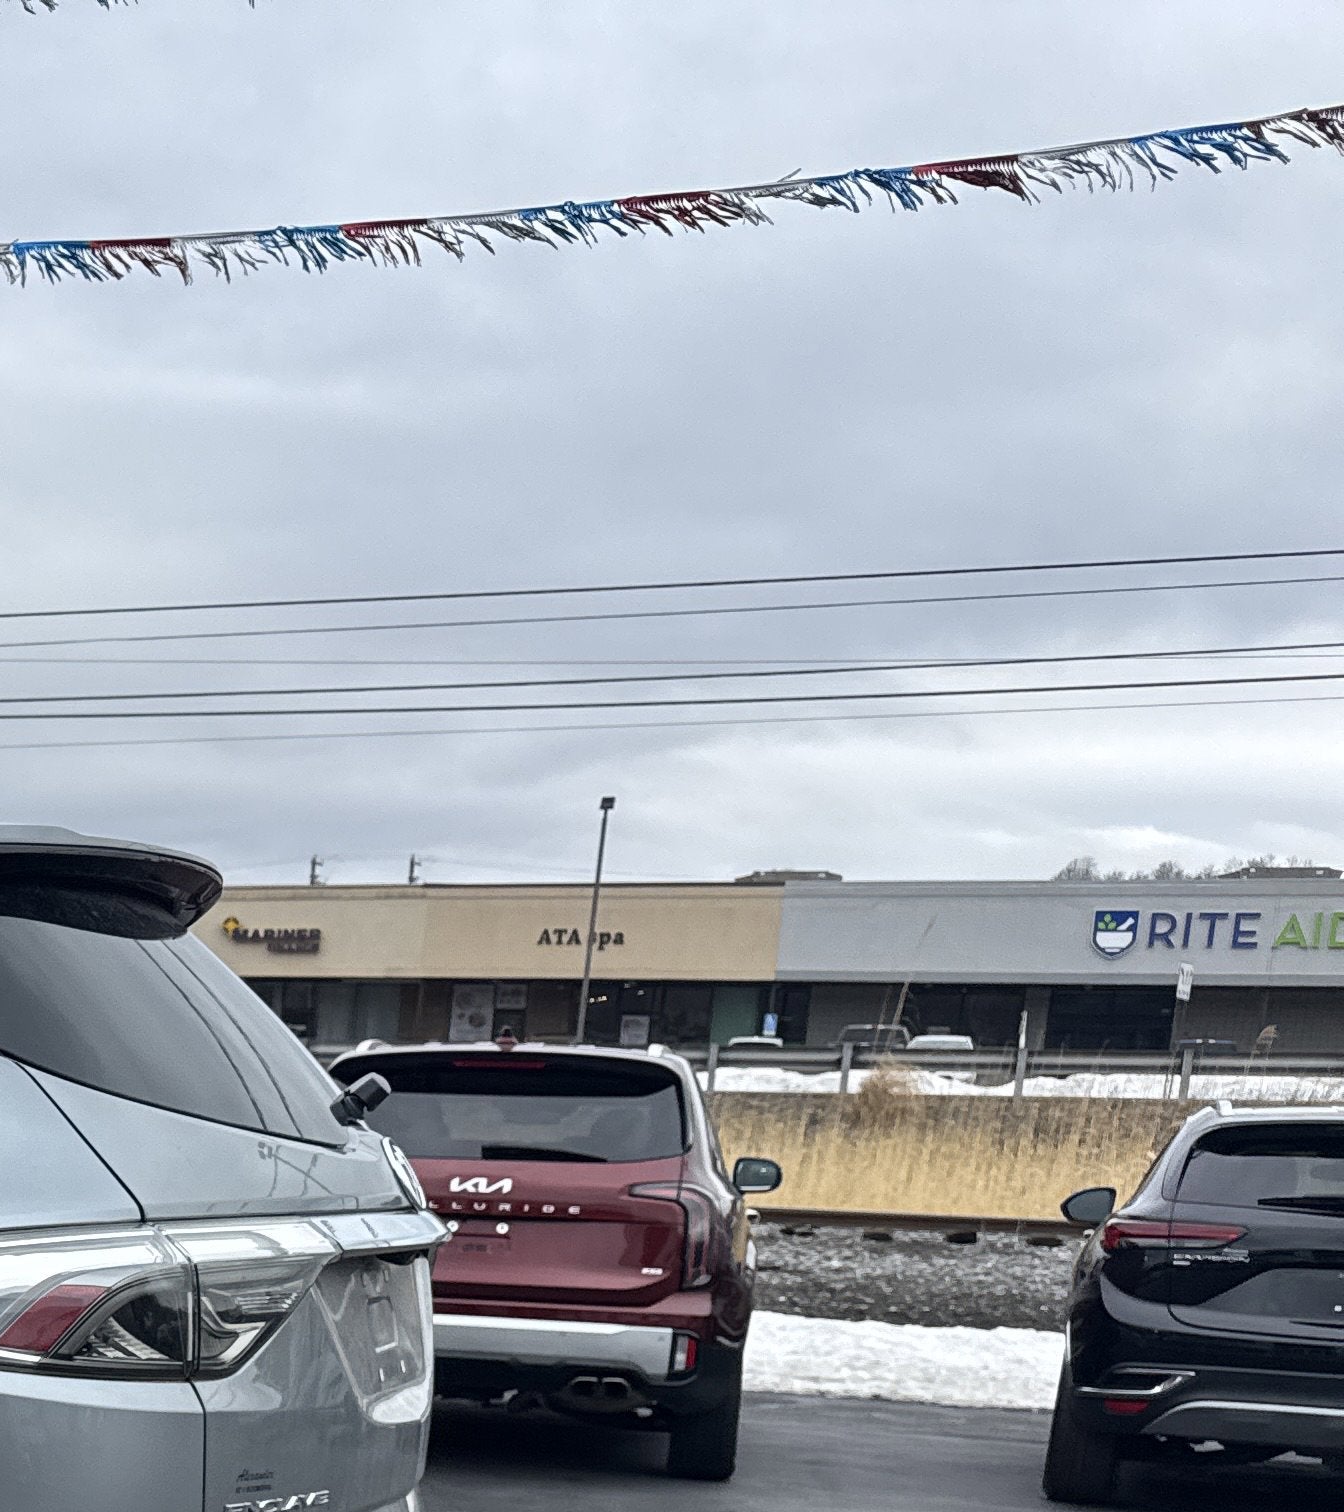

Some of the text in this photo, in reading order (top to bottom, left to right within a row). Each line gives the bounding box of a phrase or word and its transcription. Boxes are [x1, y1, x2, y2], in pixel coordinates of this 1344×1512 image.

[537, 928, 582, 945] ATA
[1148, 911, 1262, 950] RITE
[450, 1176, 513, 1194] KIA
[428, 1200, 581, 1215] LLURIDE
